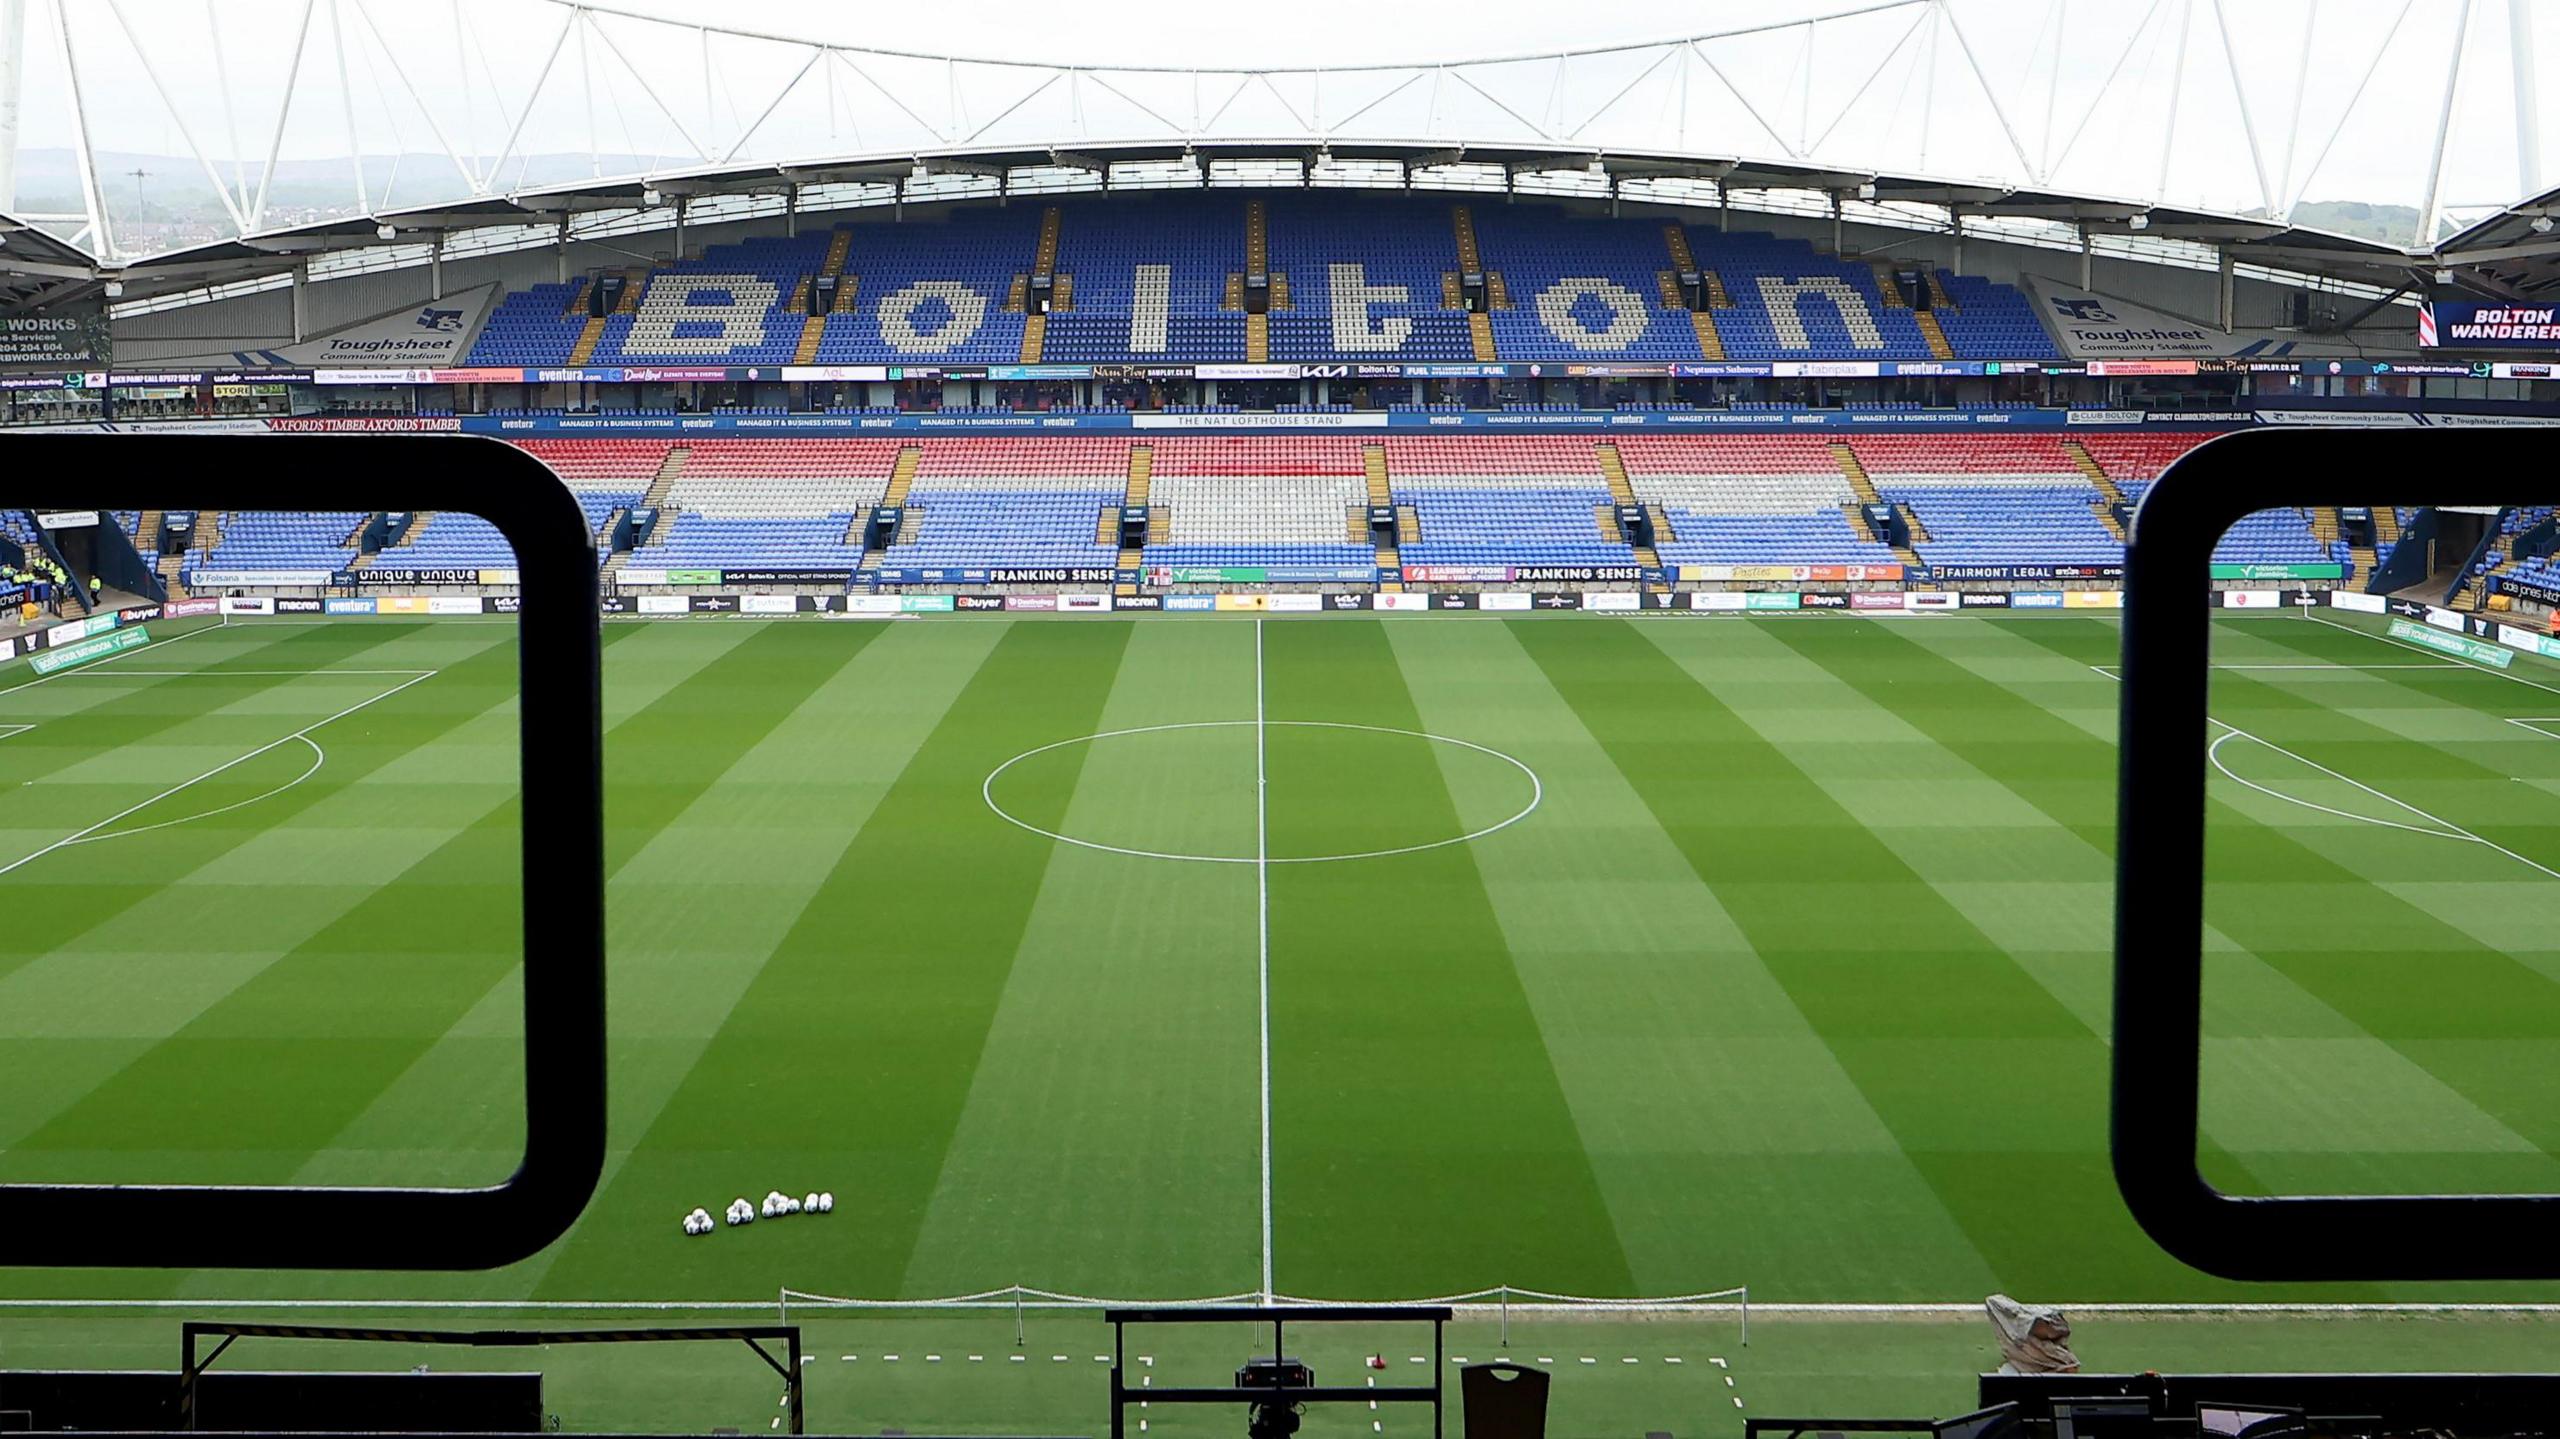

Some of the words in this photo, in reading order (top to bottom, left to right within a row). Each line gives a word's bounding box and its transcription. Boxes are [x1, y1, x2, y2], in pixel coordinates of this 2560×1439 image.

[2474, 305, 2555, 323] BOLTON
[2070, 330, 2206, 342] Toughsheet
[330, 339, 453, 352] Toughsheet
[320, 353, 390, 361] Community
[1358, 366, 1385, 374] Bolton
[1684, 365, 1725, 374] Neptunes
[1726, 365, 1770, 375] Submerge
[1898, 363, 1961, 375] eventura.com
[539, 369, 601, 381] eventura.com
[1043, 418, 1075, 426] eventura
[1176, 417, 1199, 425] THE
[1204, 417, 1227, 425] NAT
[1232, 417, 1299, 425] LOFTHOUSE
[1430, 416, 1461, 424] eventura
[1612, 415, 1643, 423] eventura
[1792, 414, 1824, 423] eventura
[1977, 414, 2008, 422] eventura
[2289, 414, 2329, 422] Toughsheet
[271, 419, 324, 431] AXFORDS
[324, 419, 366, 431] TIMBER
[366, 419, 418, 431] AXFORDS
[419, 419, 461, 432] TIMBER
[502, 420, 534, 428] eventura
[683, 419, 713, 427] eventura
[861, 419, 892, 427] eventura
[359, 571, 414, 581] unique
[421, 571, 476, 581] unique
[991, 570, 1066, 580] FRANKING
[1072, 570, 1115, 580] SENSE
[1516, 569, 1592, 579] FRANKING
[1598, 568, 1641, 578] SENSE
[1947, 568, 2008, 577] FAIRMONT
[2013, 568, 2050, 577] LEGAL
[2519, 584, 2541, 598] jones
[957, 597, 1000, 609] ebuyer
[1117, 598, 1157, 606] macron
[1168, 597, 1208, 608] eventura
[1964, 595, 2005, 604] macron
[279, 601, 320, 610] macron
[329, 601, 370, 612] eventura
